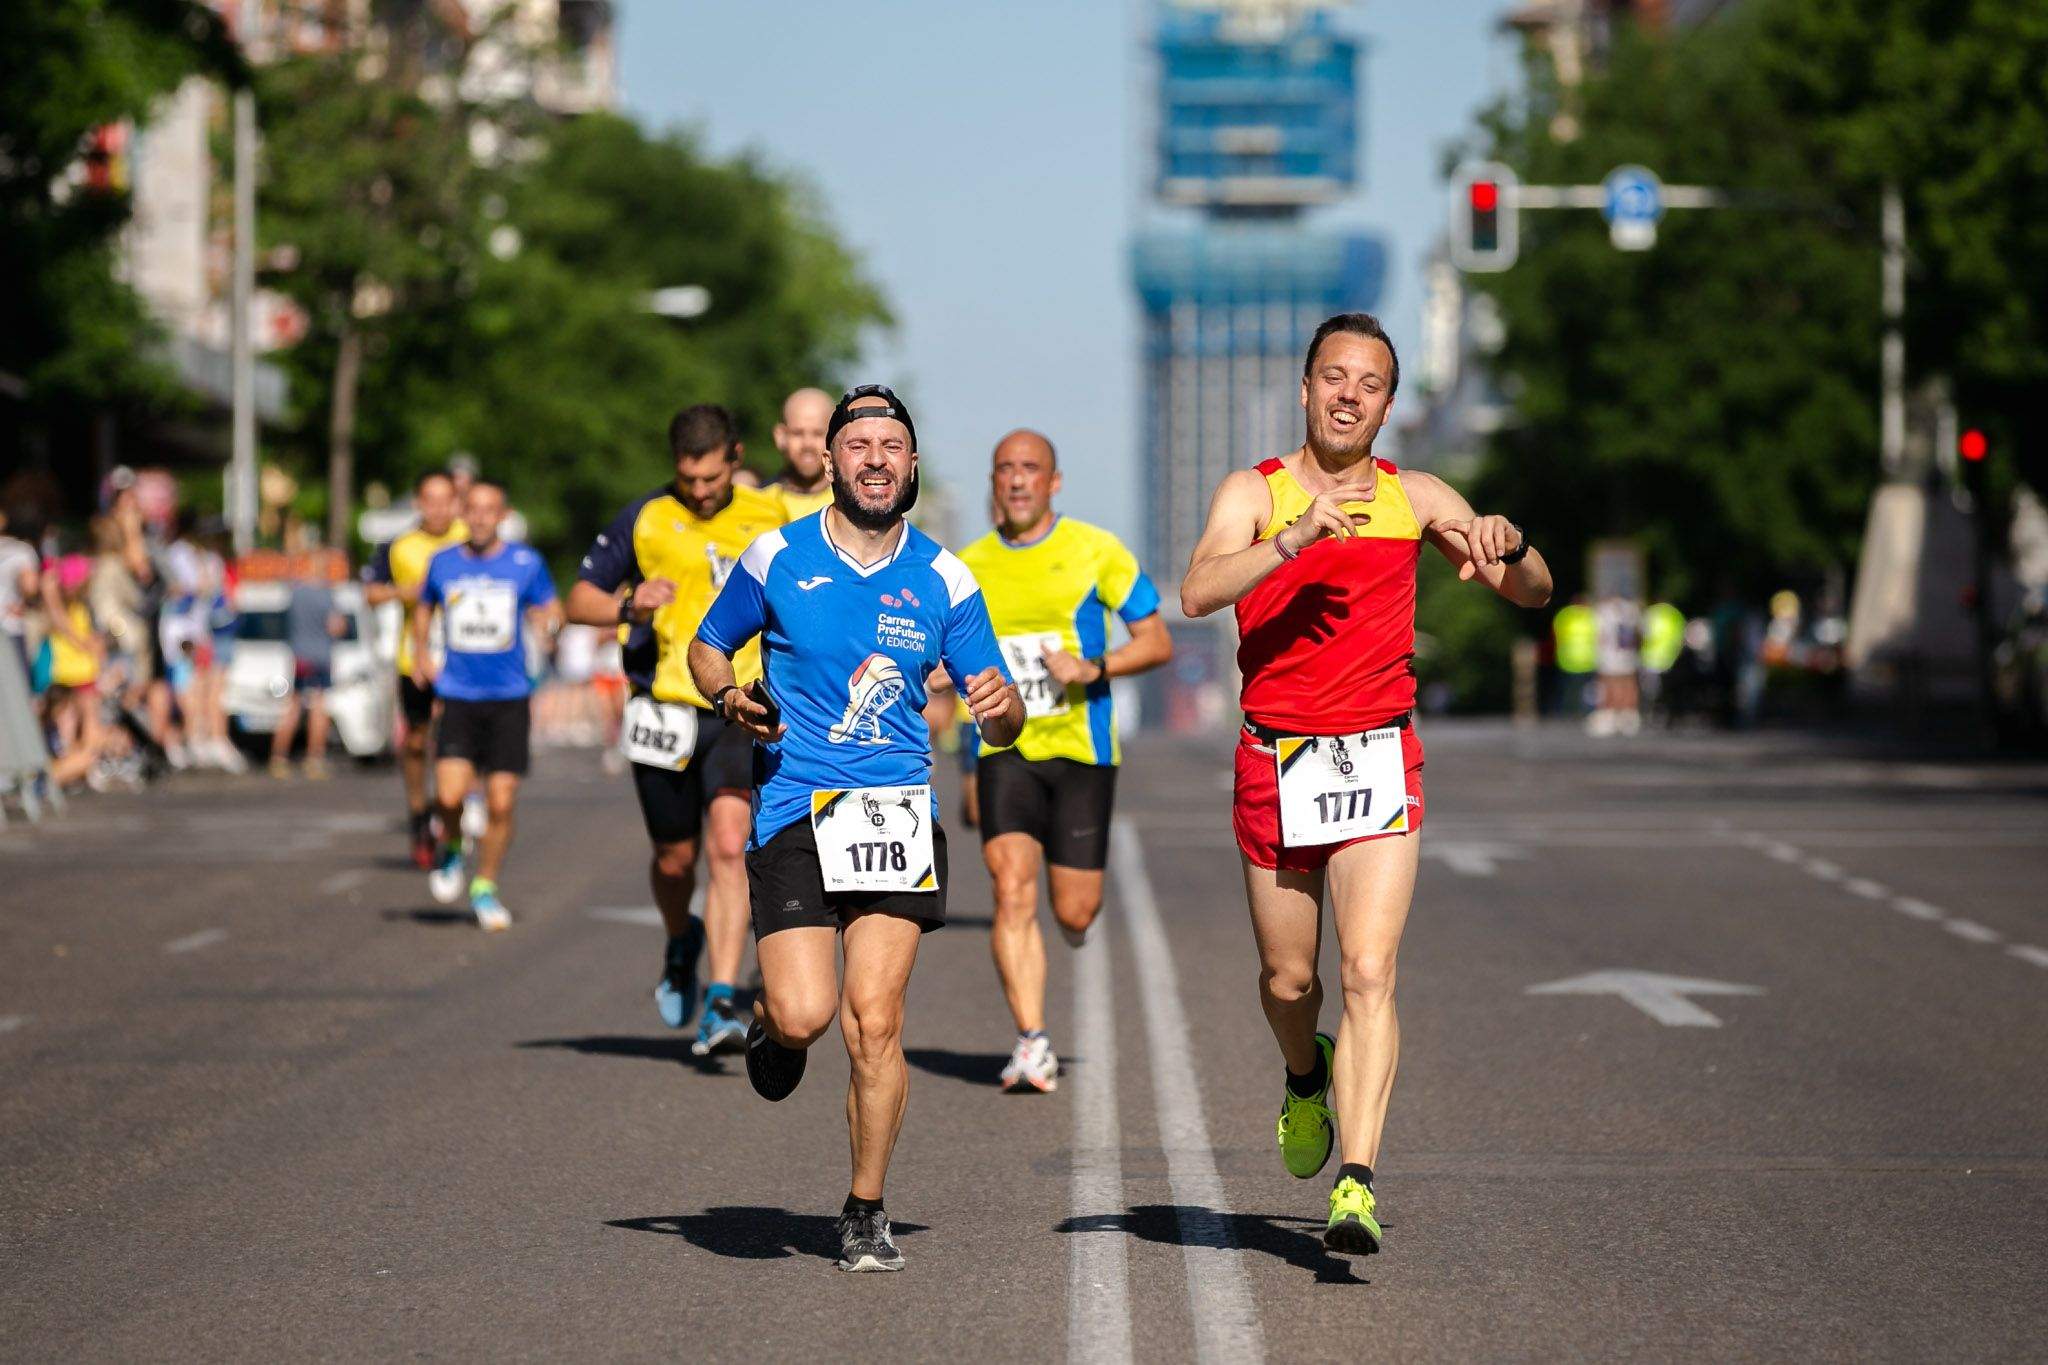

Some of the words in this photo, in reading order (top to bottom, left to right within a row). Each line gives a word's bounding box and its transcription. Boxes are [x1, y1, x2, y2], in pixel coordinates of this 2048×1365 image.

[878, 613, 915, 628] Carrera
[877, 624, 926, 641] ProFuturo
[877, 636, 885, 646] V
[887, 637, 925, 652] EDICIÓN
[1314, 788, 1373, 824] 1777
[846, 841, 907, 872] 1778
